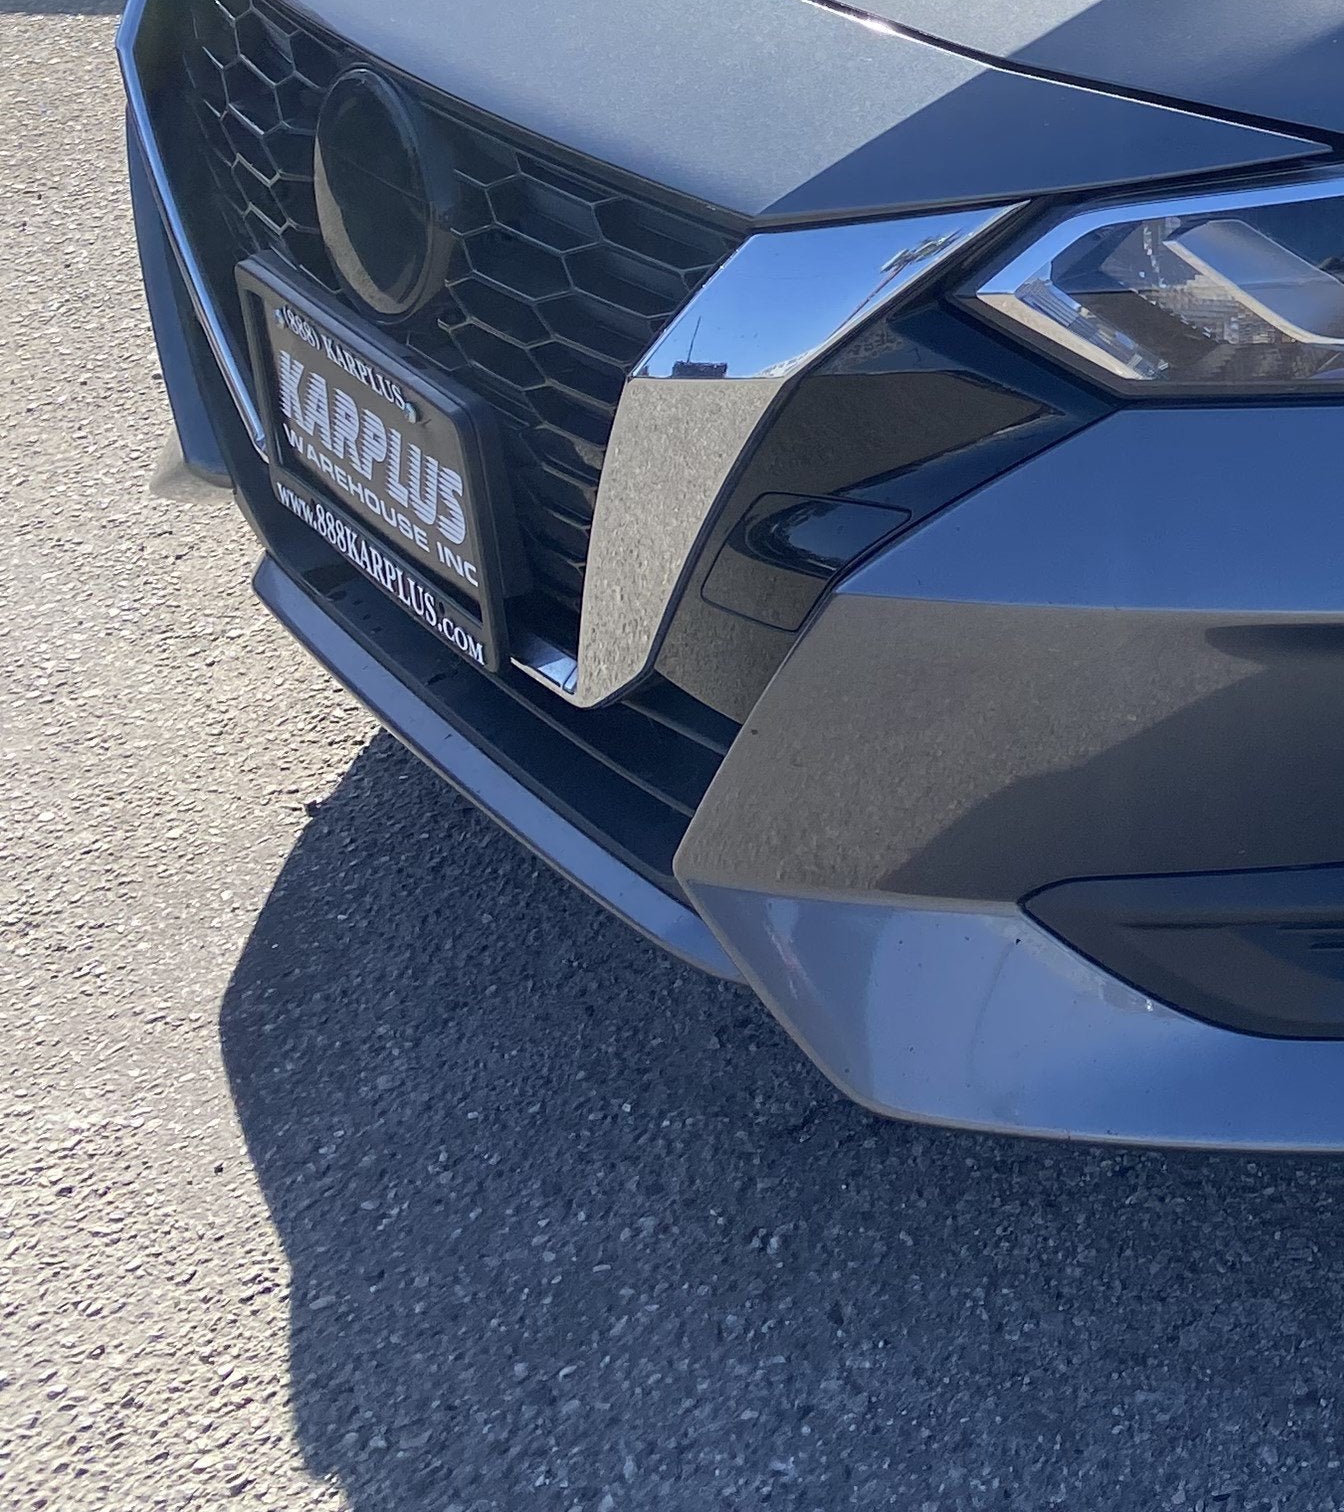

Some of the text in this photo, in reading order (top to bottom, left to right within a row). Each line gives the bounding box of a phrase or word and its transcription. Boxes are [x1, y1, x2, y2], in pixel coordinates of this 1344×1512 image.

[282, 305, 406, 411] (888) KARPLUS
[279, 349, 467, 546] KARPLUS
[282, 422, 479, 587] WAREHOUSE INC
